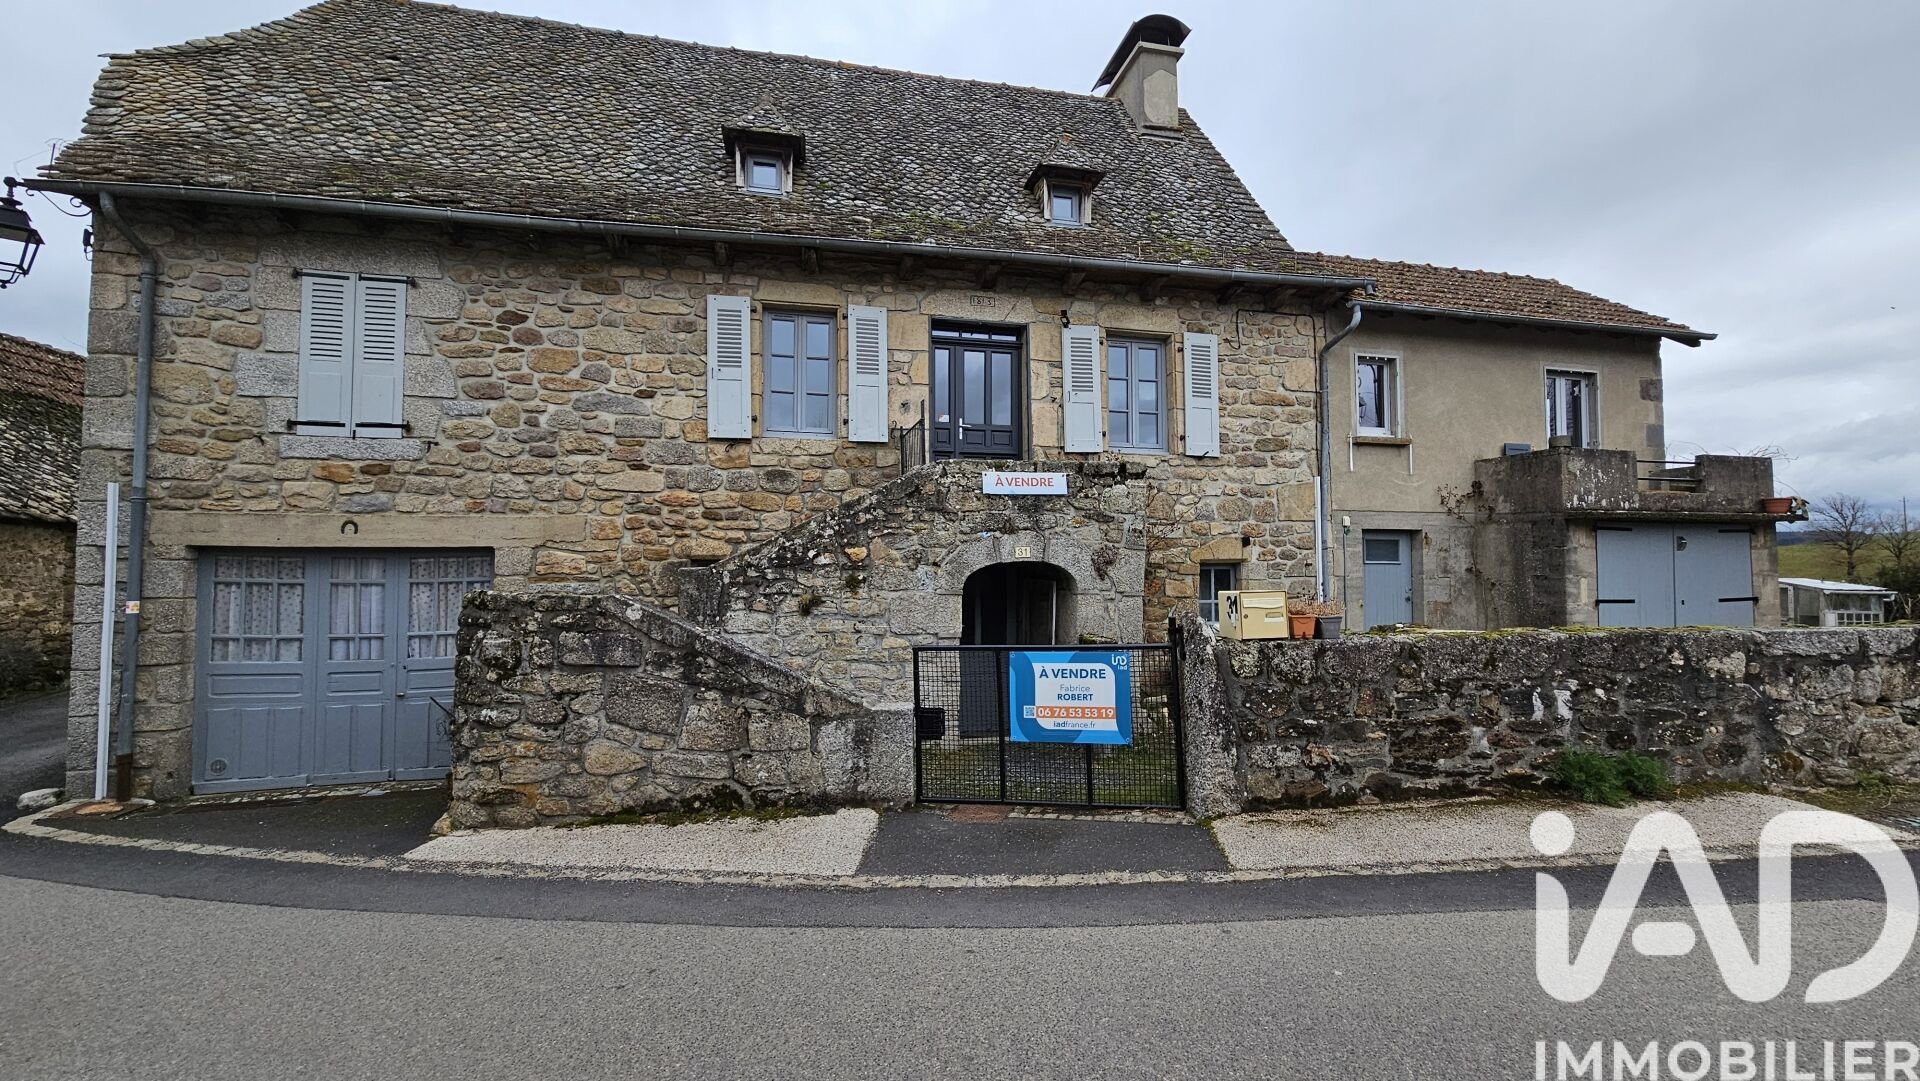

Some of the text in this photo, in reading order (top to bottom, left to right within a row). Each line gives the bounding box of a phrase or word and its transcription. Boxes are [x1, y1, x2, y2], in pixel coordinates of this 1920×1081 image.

[995, 475, 1054, 487] À VENDRE
[1017, 547, 1028, 557] 31
[1039, 666, 1107, 679] À VENDRE
[1060, 684, 1091, 692] Fabrice
[1057, 693, 1094, 701] ROBERT
[1037, 708, 1114, 718] 06 76 53 53 19
[1053, 721, 1096, 729] iadfrance.fr
